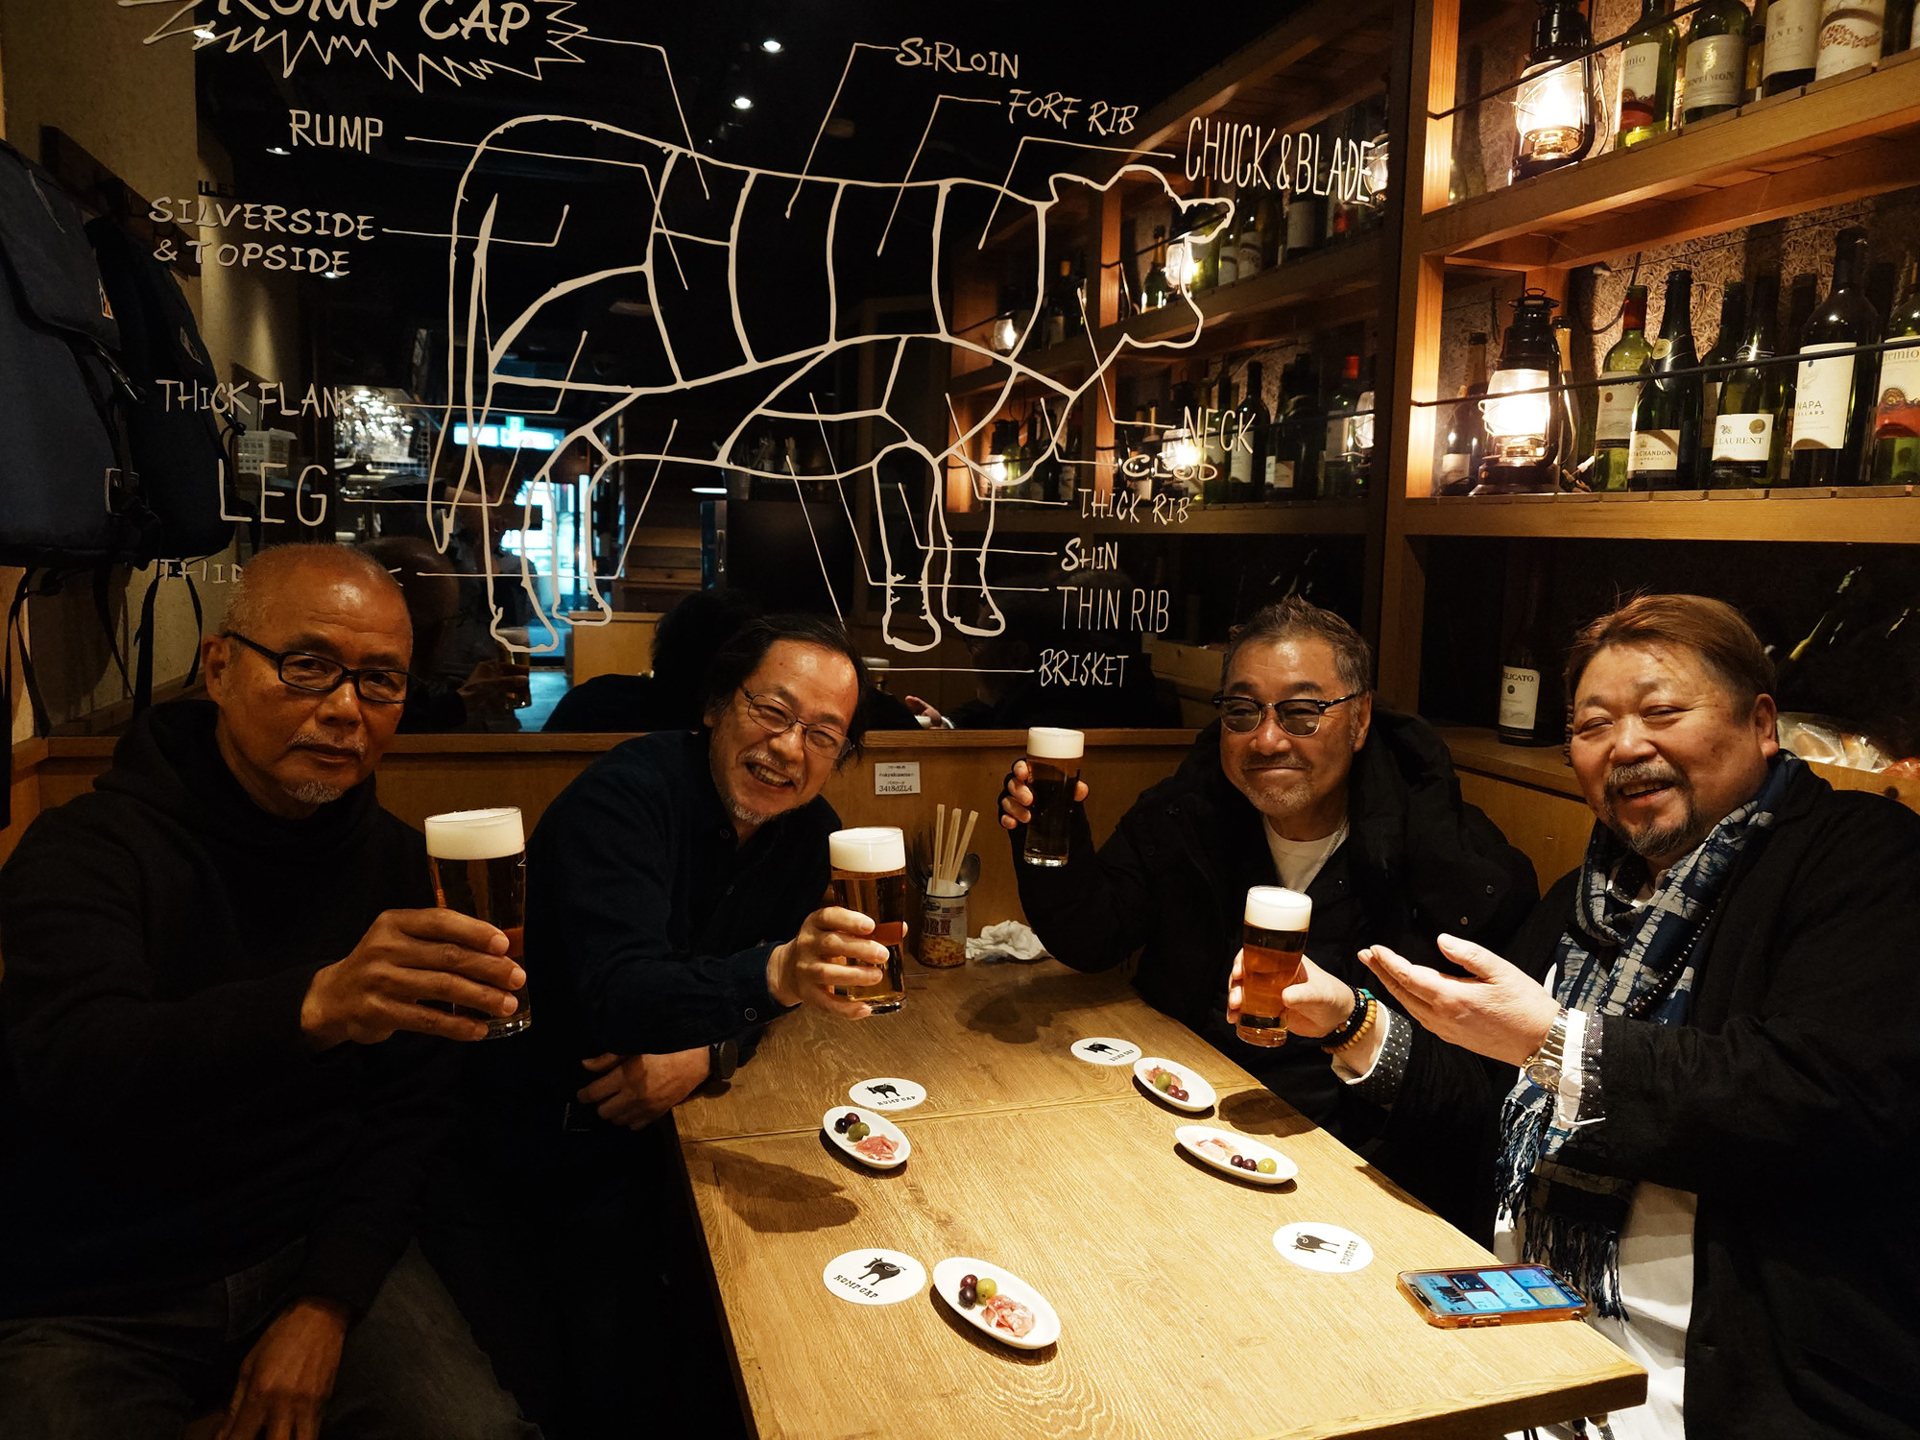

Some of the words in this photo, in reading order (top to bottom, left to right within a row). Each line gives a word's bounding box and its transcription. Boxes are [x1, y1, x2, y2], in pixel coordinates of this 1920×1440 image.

[419, 0, 530, 45] CAP
[894, 37, 1018, 79] SIRLOIN
[289, 109, 383, 154] RUMP
[1087, 101, 1139, 137] RIB
[1185, 116, 1276, 191] CHUCK
[1276, 133, 1292, 190] &
[1296, 132, 1374, 203] BLADE
[149, 196, 375, 242] SILVERSIDE
[152, 239, 178, 262] &
[185, 240, 351, 277] TOPSIDE
[155, 379, 251, 414] THICK
[257, 381, 363, 421] FLANK
[1181, 405, 1256, 454] NECK
[1122, 454, 1218, 481] CLOD
[218, 459, 328, 526] LEG
[1077, 488, 1141, 523] THICK
[1152, 493, 1191, 525] RIB
[1061, 537, 1118, 571] SHIN
[1056, 586, 1120, 631] THIN
[1130, 588, 1169, 634] RIB
[1038, 648, 1129, 688] BRISKET
[859, 1287, 879, 1299] CAP
